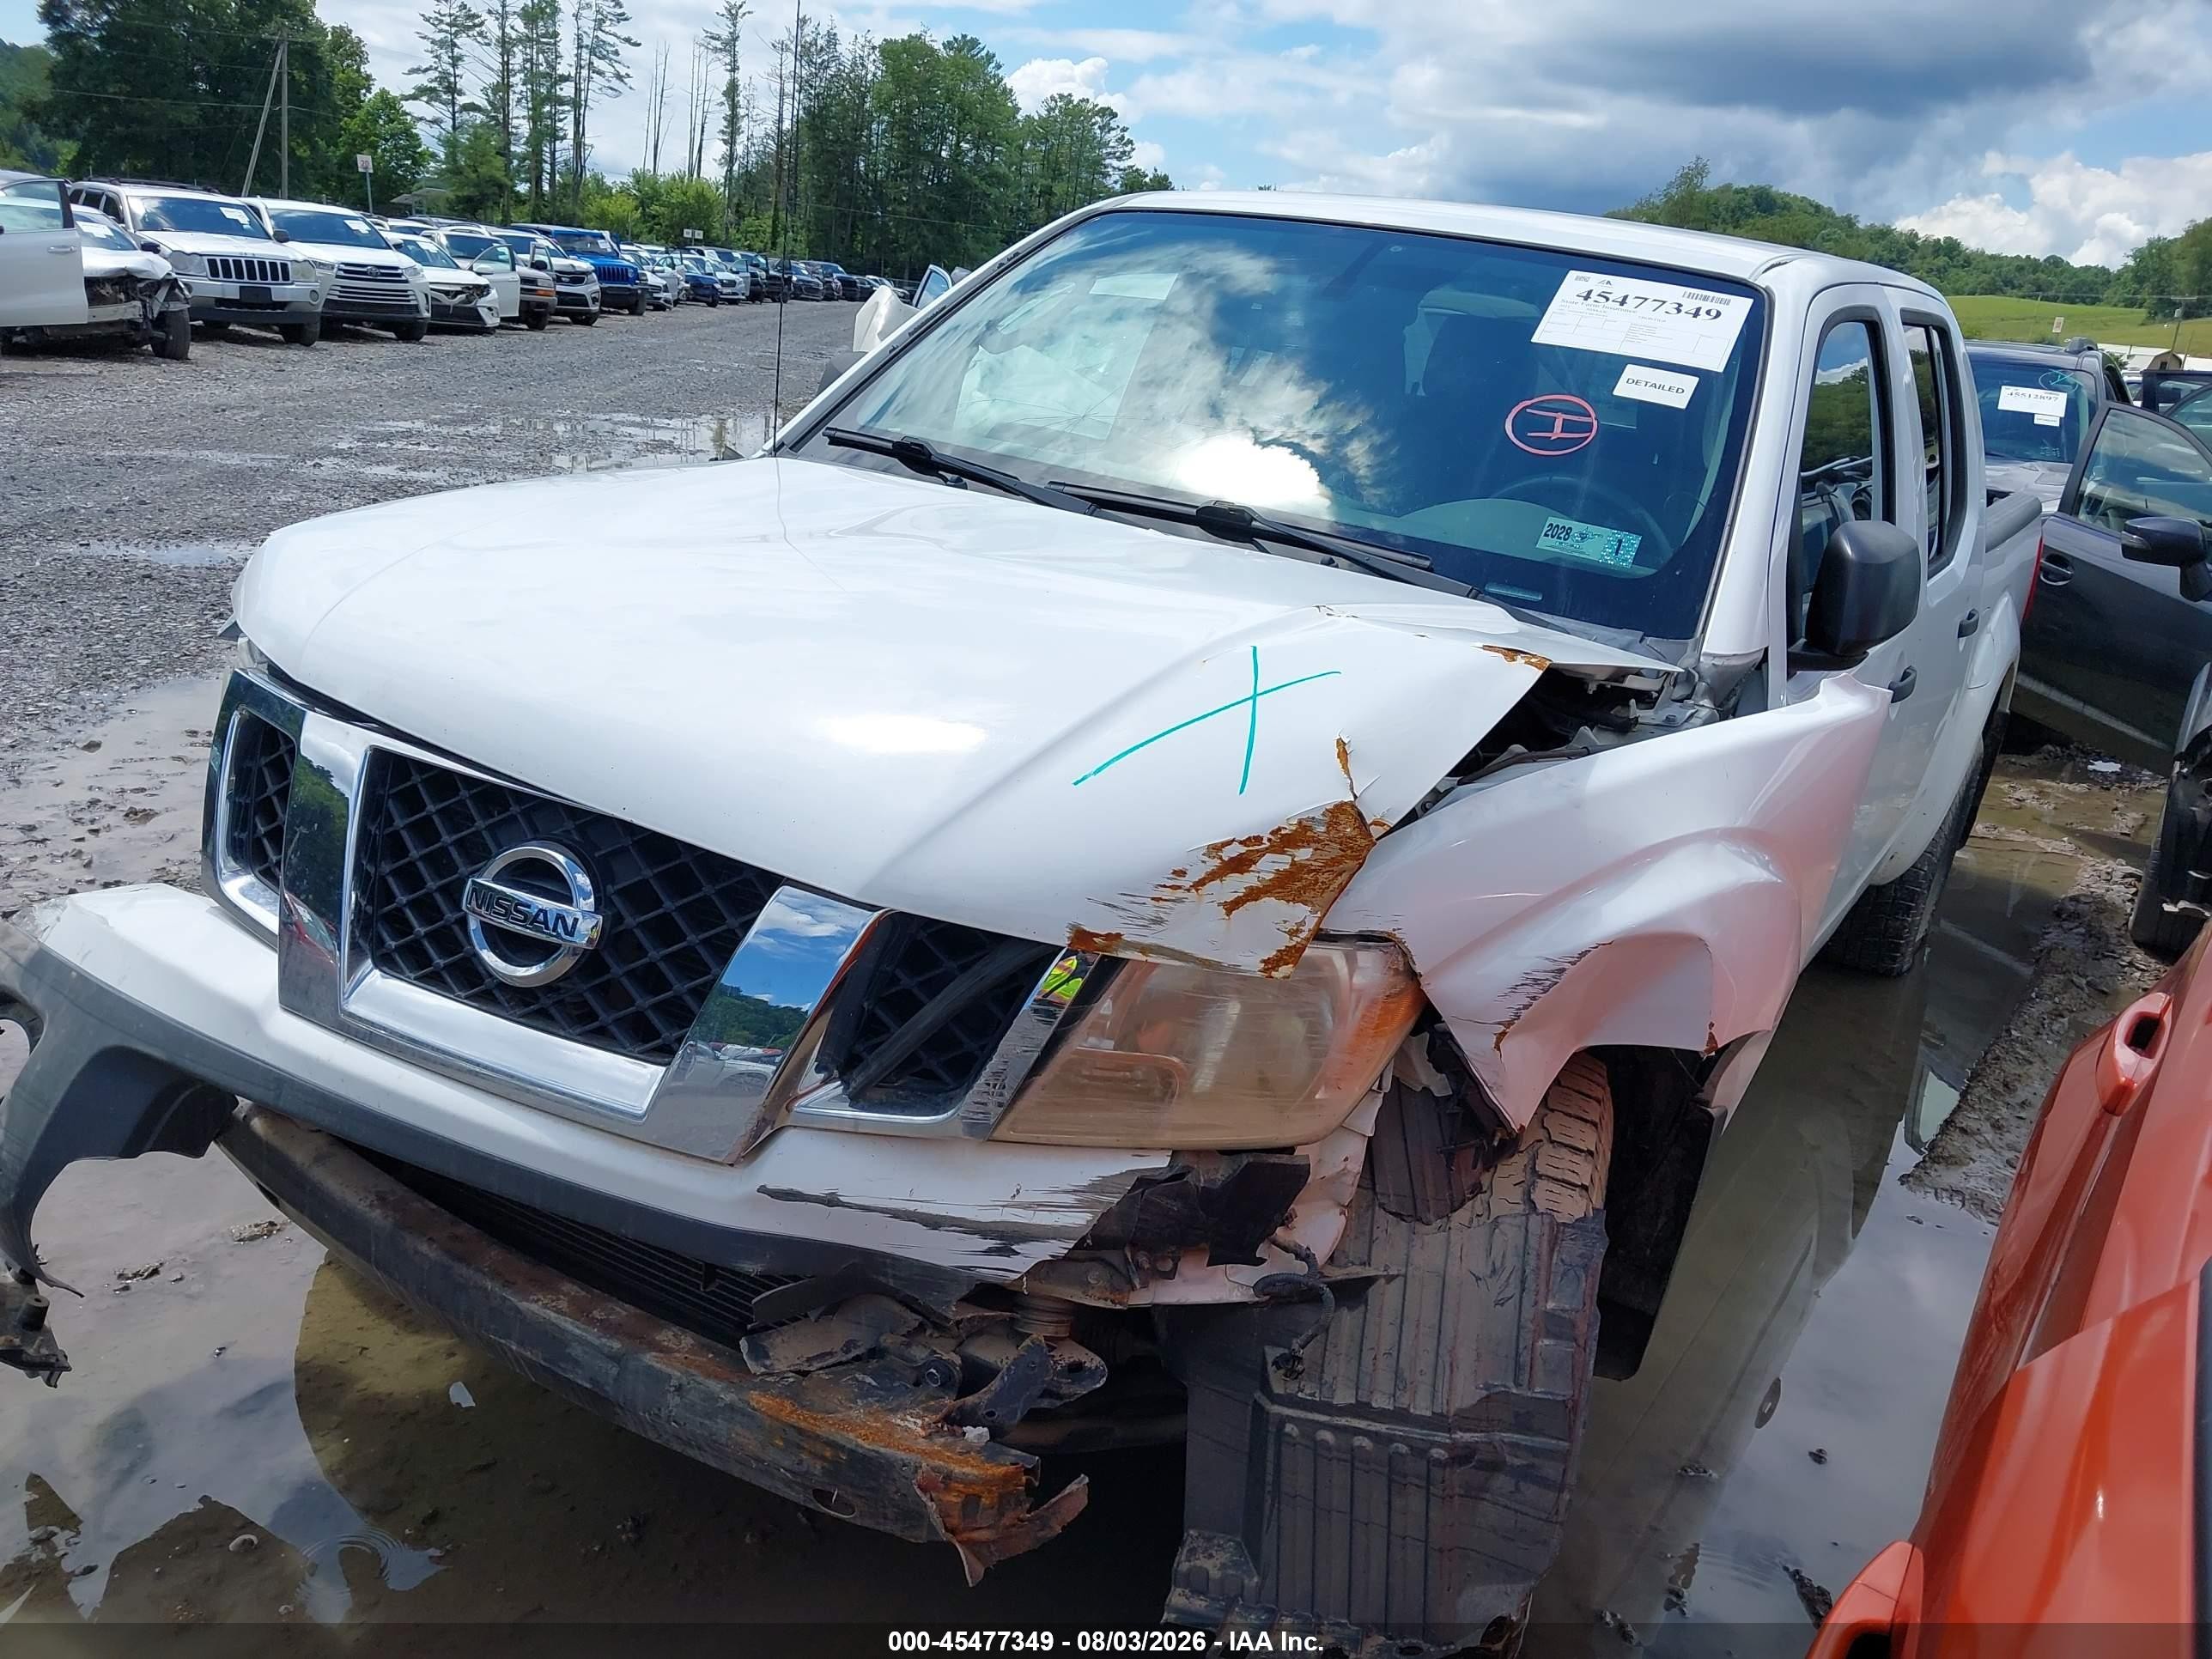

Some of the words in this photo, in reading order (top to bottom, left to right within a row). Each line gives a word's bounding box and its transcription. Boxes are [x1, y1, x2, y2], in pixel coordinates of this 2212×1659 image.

[1576, 289, 1722, 321] 45477349
[1626, 377, 1685, 395] DETAILED
[1543, 522, 1573, 542] 2028
[467, 885, 580, 938] NISSAN
